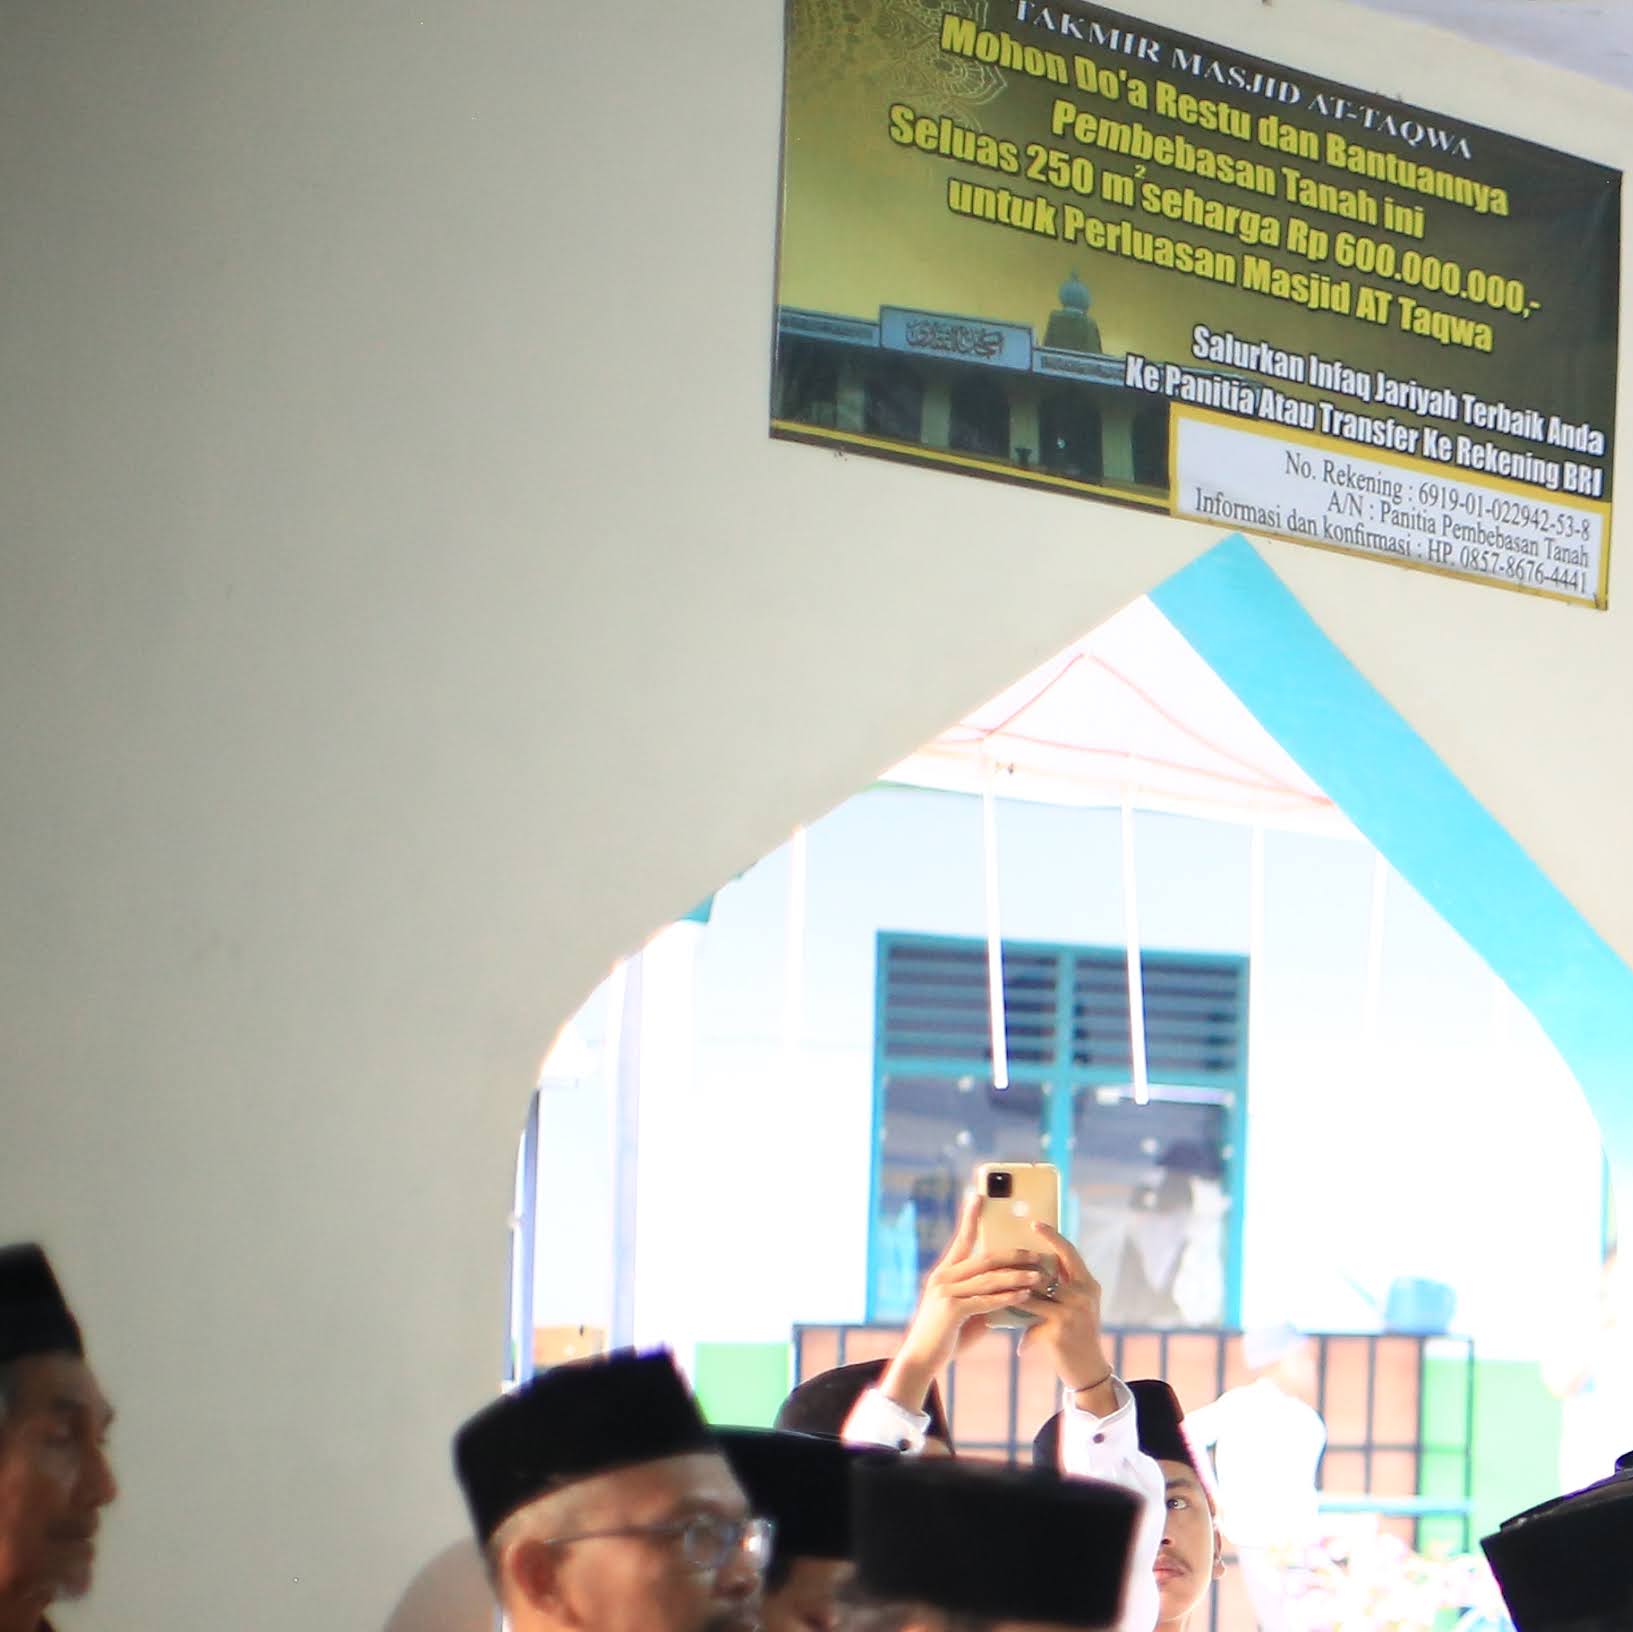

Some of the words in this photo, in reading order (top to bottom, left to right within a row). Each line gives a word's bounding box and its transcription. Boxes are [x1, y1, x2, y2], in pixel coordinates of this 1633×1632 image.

[940, 14, 1069, 85] Mohon
[1074, 55, 1148, 110] Do'a
[1155, 80, 1251, 141] Restu
[1258, 115, 1320, 161] dan
[1326, 132, 1510, 216] Bantuannya
[1016, 0, 1160, 63] TAKMIR
[1171, 48, 1300, 104] MASJID
[1308, 93, 1472, 159] AT-TAQWA
[889, 103, 1020, 174] Seluas
[1025, 143, 1095, 195] 250
[1141, 181, 1281, 248] seharga
[1287, 217, 1329, 261] Rp
[1335, 231, 1541, 319] 600.000.000,-
[1052, 99, 1276, 196] Pembebasan
[1281, 167, 1379, 226] Tanah
[1384, 195, 1425, 239] ini
[948, 178, 1057, 238] untuk
[1062, 204, 1237, 285] Perluasan
[1242, 254, 1351, 316] Masjid
[1355, 285, 1393, 326] AT
[1398, 296, 1494, 353] Taqwa
[1125, 354, 1161, 392] Ke
[1165, 364, 1256, 416] Panitia
[1258, 387, 1316, 431] Atau
[1319, 403, 1419, 454] Transfer
[1422, 426, 1453, 462] Ke
[1456, 435, 1561, 491] Rekening
[1563, 460, 1604, 498] BRI
[1192, 325, 1305, 384] Salurkan
[1309, 354, 1371, 403] Infaq
[1374, 371, 1459, 421] Jariyah
[1462, 393, 1545, 443] Terbaik
[1546, 415, 1605, 457] Anda
[1195, 487, 1282, 529] Informasi
[1286, 508, 1318, 536] dan
[1323, 515, 1411, 556] konfirmasi
[1285, 450, 1316, 480] No.
[1323, 459, 1403, 504] Rekening
[1418, 482, 1590, 541] 6919-01-022942-53-8
[1328, 490, 1365, 518] A/N
[1380, 500, 1436, 534] Panitia
[1442, 514, 1539, 556] Pembebasan
[1544, 537, 1590, 568] Tanah
